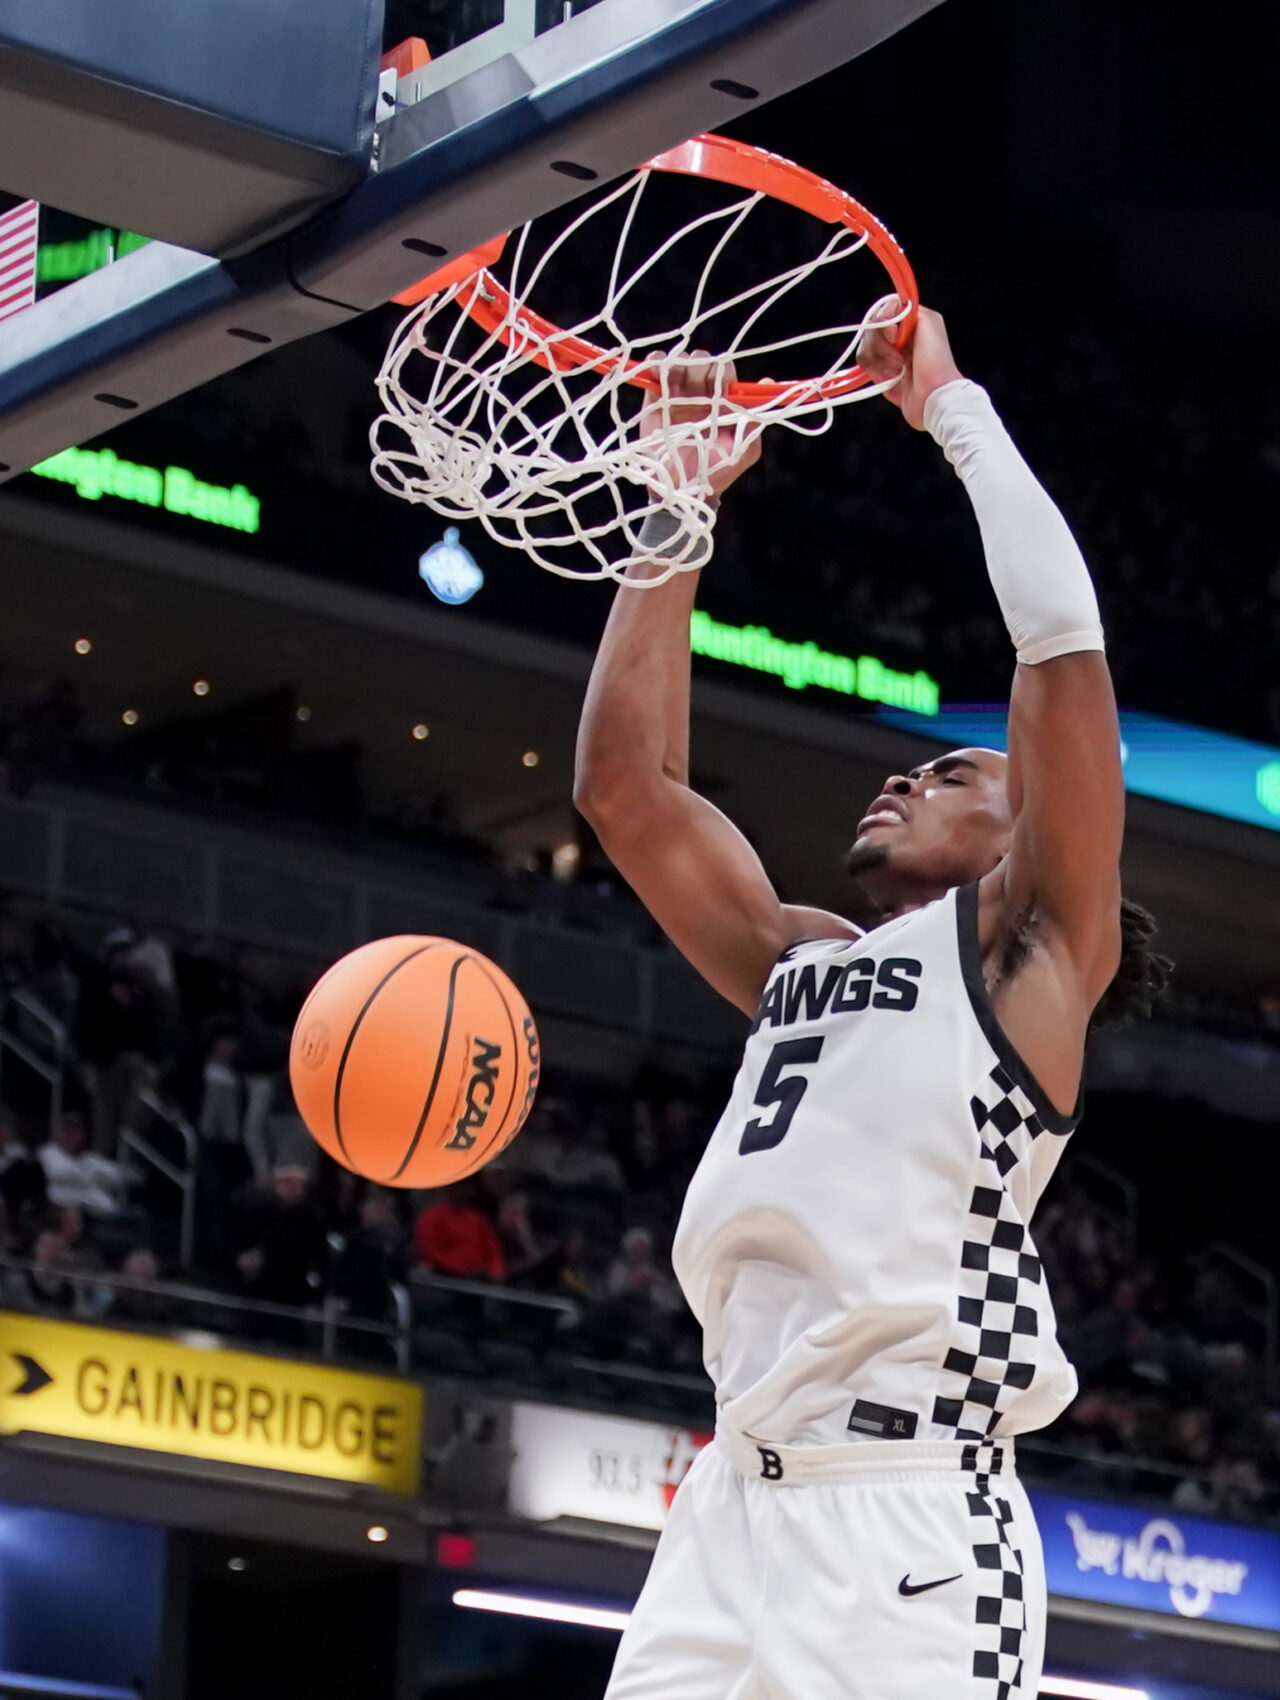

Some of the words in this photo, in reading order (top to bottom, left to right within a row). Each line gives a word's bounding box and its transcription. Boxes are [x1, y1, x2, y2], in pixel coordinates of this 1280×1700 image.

[164, 466, 260, 534] Bank
[857, 655, 940, 717] Bank
[751, 957, 923, 1036] AWGS
[444, 1036, 502, 1151] NCAA
[738, 1034, 825, 1156] 5
[75, 1356, 401, 1465] GAINBRIDGE
[891, 1417, 907, 1433] XL
[757, 1446, 784, 1481] B
